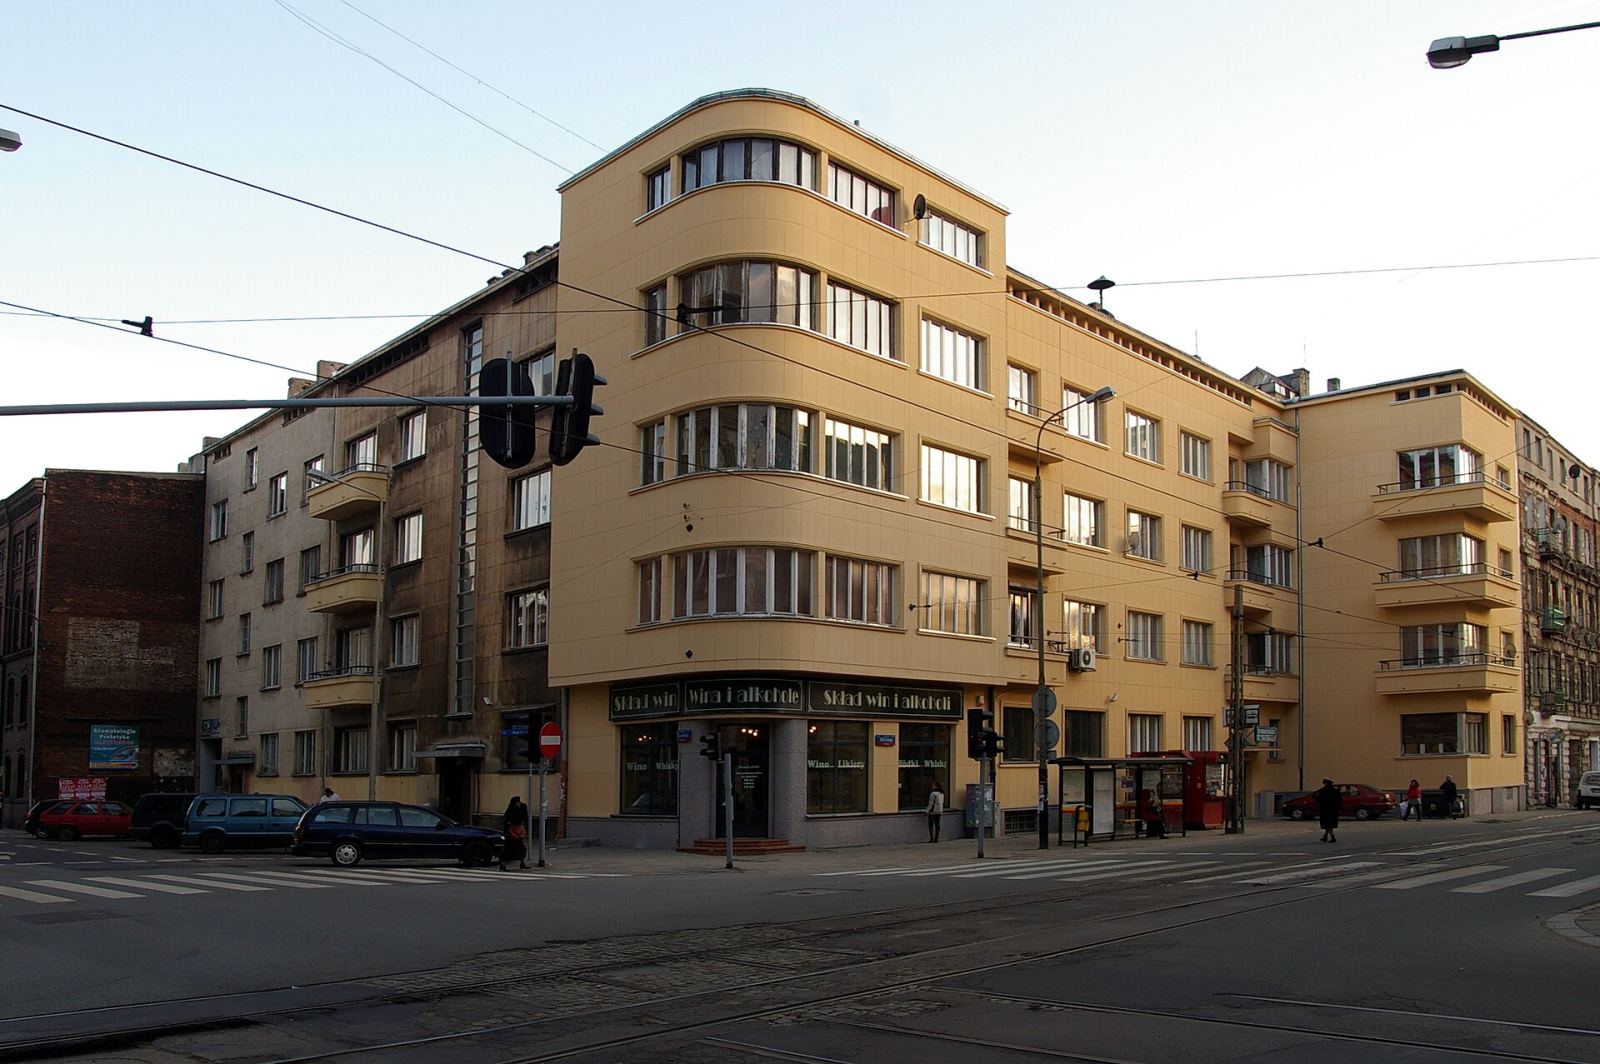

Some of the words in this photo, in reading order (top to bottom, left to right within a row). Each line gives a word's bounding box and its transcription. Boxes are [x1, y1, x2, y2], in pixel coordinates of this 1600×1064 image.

[613, 694, 649, 712] Skład
[652, 691, 676, 707] win
[689, 688, 721, 705] Wina
[727, 686, 732, 703] i
[736, 686, 799, 705] alkohole
[824, 689, 862, 707] Skład
[866, 692, 890, 708] win
[894, 693, 899, 708] i
[901, 695, 951, 711] alkoholi
[626, 762, 648, 771] Wino
[807, 760, 830, 768] Wino
[924, 760, 948, 769] Whisky
